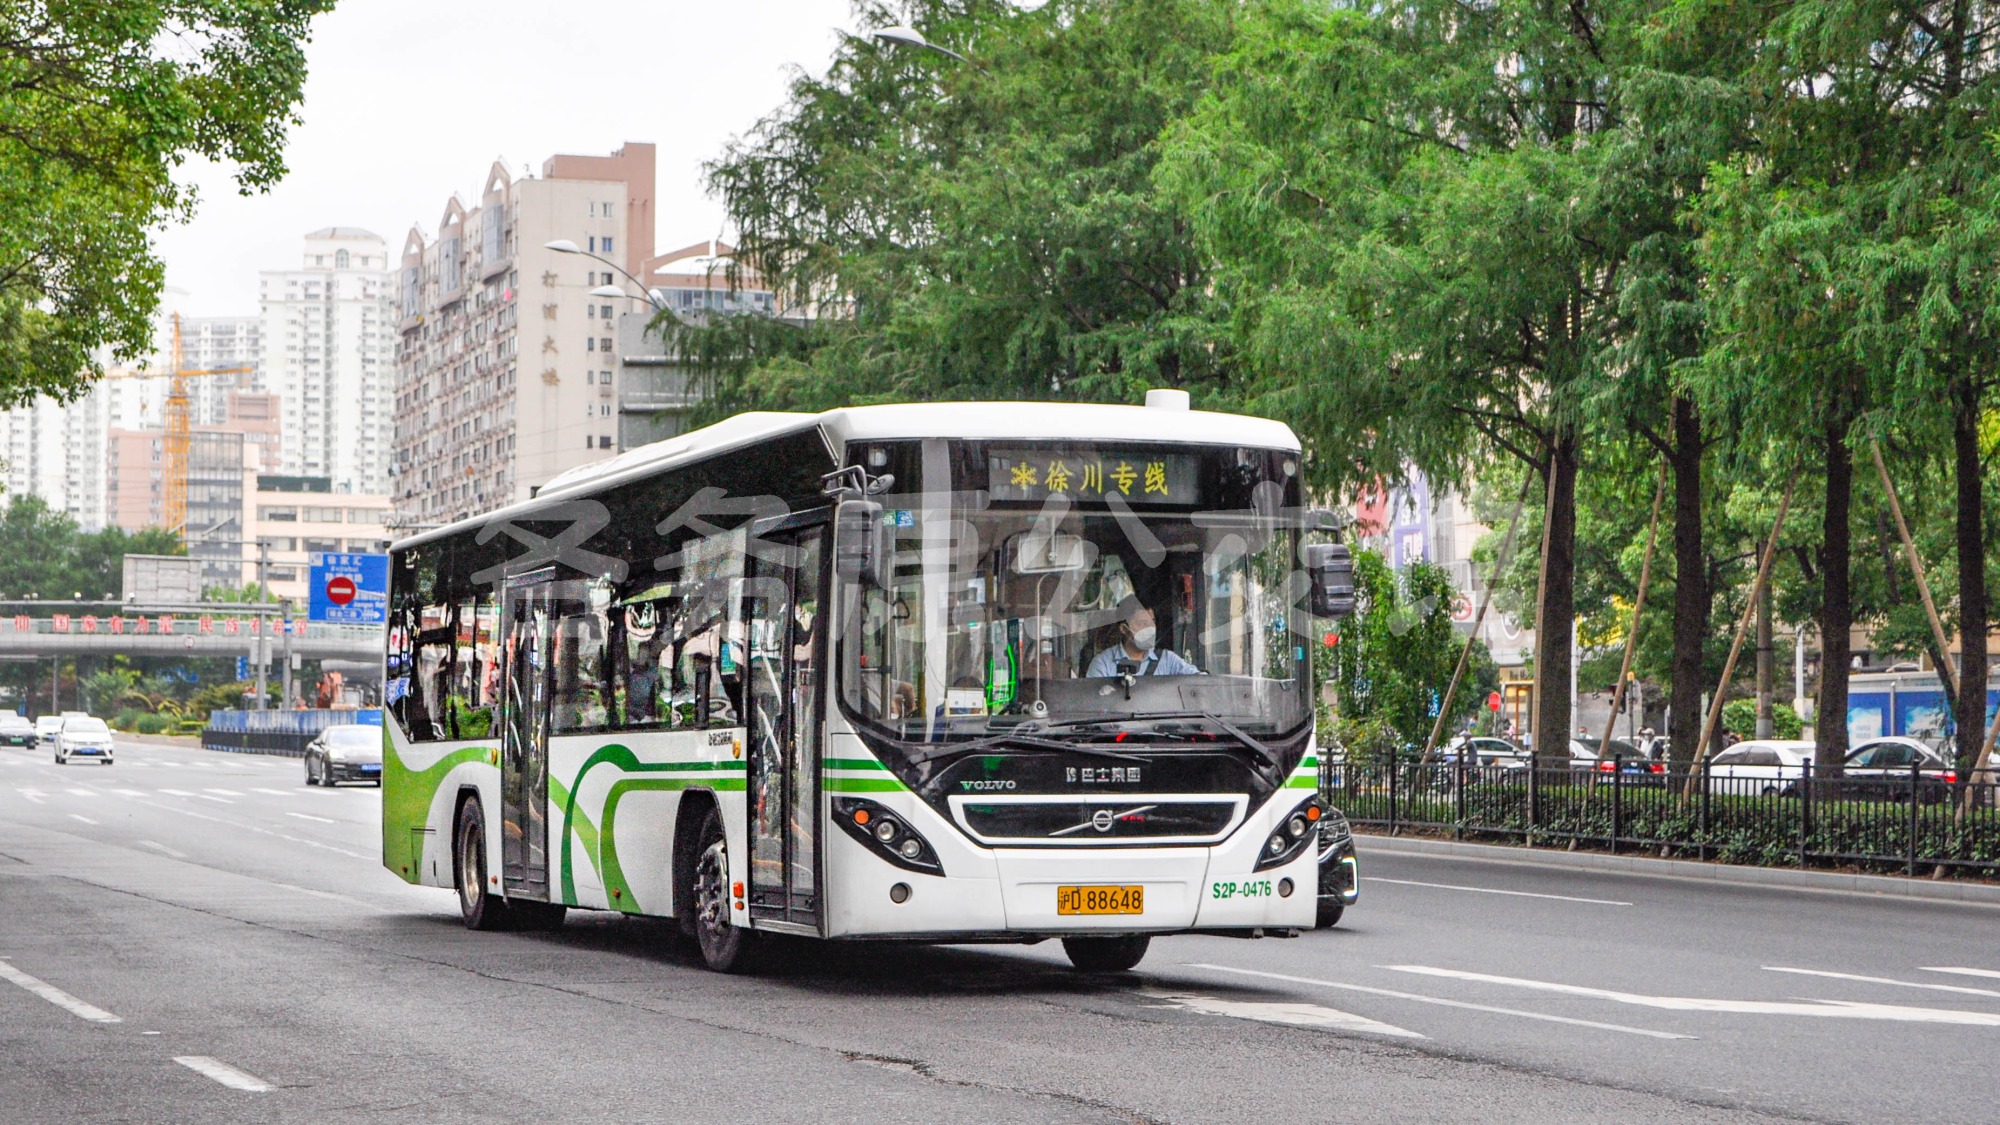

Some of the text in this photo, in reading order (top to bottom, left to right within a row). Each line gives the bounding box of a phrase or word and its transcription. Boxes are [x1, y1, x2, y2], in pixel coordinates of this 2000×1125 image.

[1045, 460, 1168, 496] 徐川专线
[53, 614, 173, 634] 国家有力量
[960, 780, 1016, 790] VOLVO
[1213, 881, 1272, 899] S2P-0476
